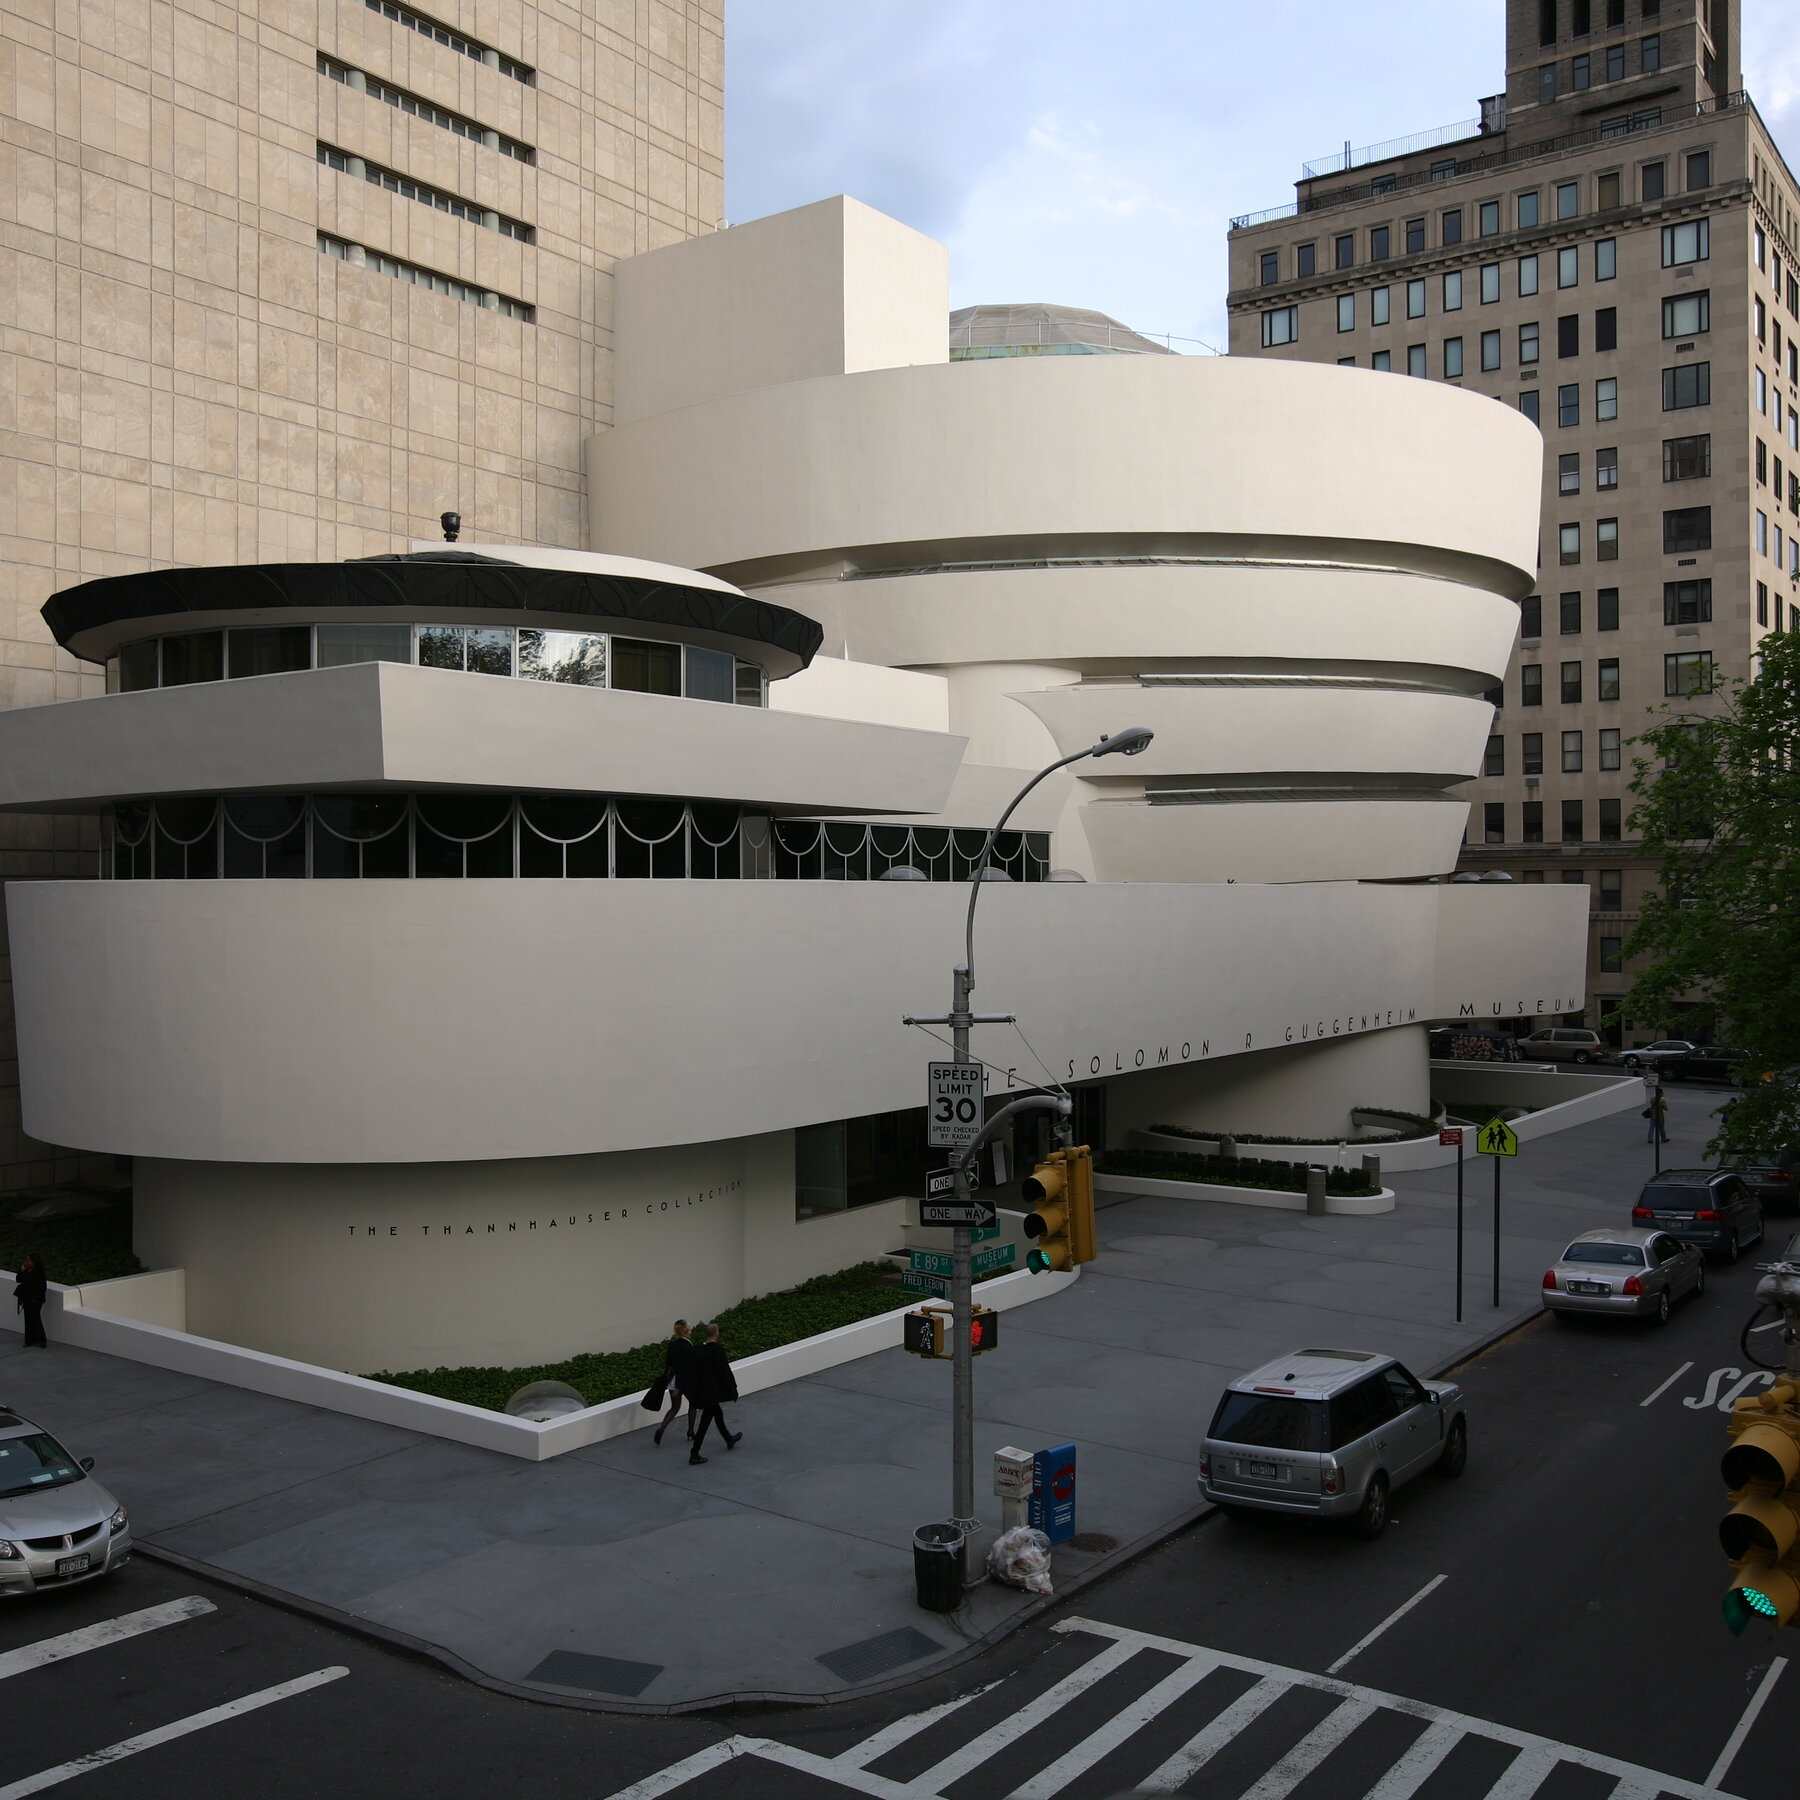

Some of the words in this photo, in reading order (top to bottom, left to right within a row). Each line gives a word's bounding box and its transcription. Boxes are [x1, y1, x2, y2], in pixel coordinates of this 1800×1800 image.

[1067, 1039, 1210, 1078] SOLOMON
[1245, 1032, 1252, 1049] R
[1285, 1008, 1416, 1042] GUGGENHEIM
[1459, 999, 1575, 1016] MUSEUM
[933, 1069, 979, 1081] SPEED
[938, 1083, 973, 1094] LIMIT
[934, 1096, 976, 1123] 30
[932, 1125, 951, 1133] SPEED
[953, 1126, 980, 1134] CHECKED
[934, 1176, 949, 1190] ONE
[348, 1226, 398, 1236] THE
[422, 1209, 628, 1236] THANNHAUSER
[930, 1208, 951, 1219] ONE
[964, 1208, 986, 1220] WAY
[914, 1253, 921, 1268] E
[924, 1255, 938, 1271] 89
[940, 1258, 949, 1266] ST
[976, 1247, 1009, 1266] MUSEUM
[903, 1274, 922, 1286] FRED
[924, 1277, 944, 1292] LEBOW
[1033, 1499, 1041, 1525] TOW
